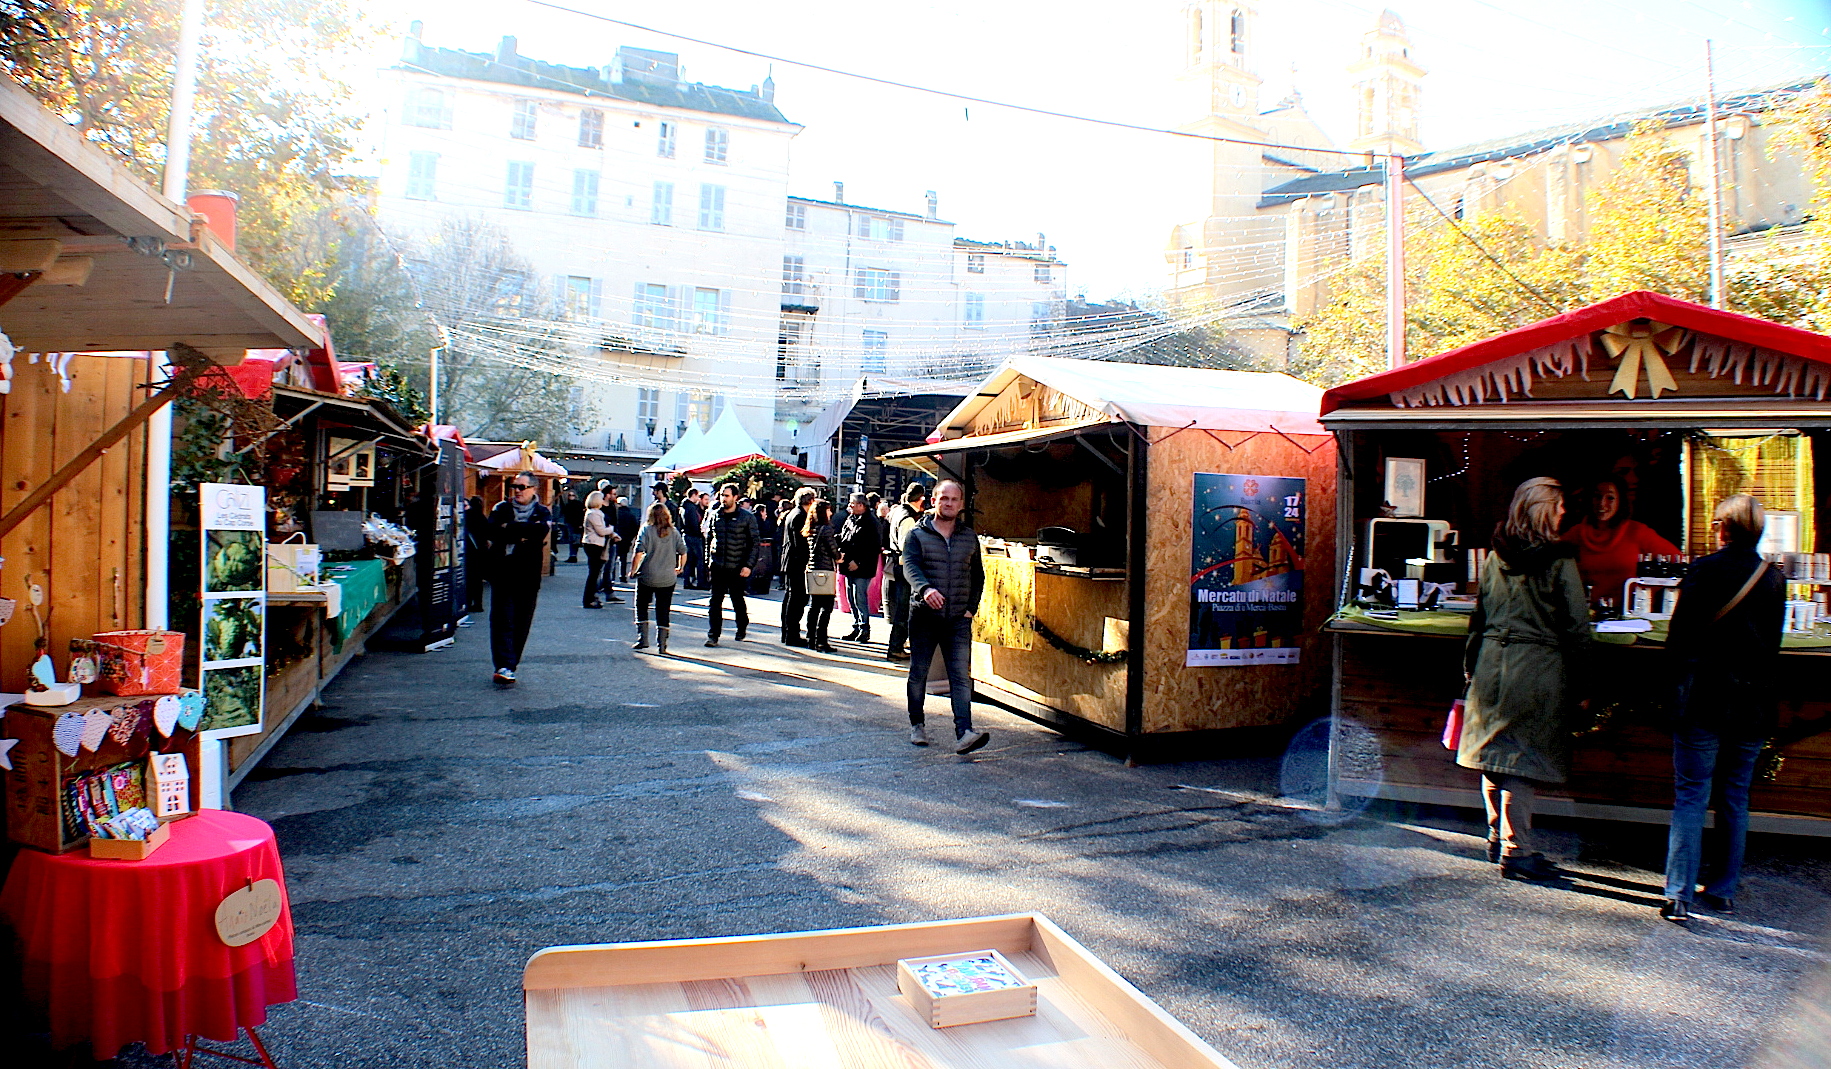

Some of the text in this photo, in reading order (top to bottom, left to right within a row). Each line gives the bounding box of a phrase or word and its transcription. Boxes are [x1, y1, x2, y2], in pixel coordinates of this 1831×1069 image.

[1284, 496, 1300, 507] 17
[1284, 507, 1300, 518] 24
[1197, 588, 1297, 603] Mercatu di Natale
[1212, 603, 1234, 612] Piazza
